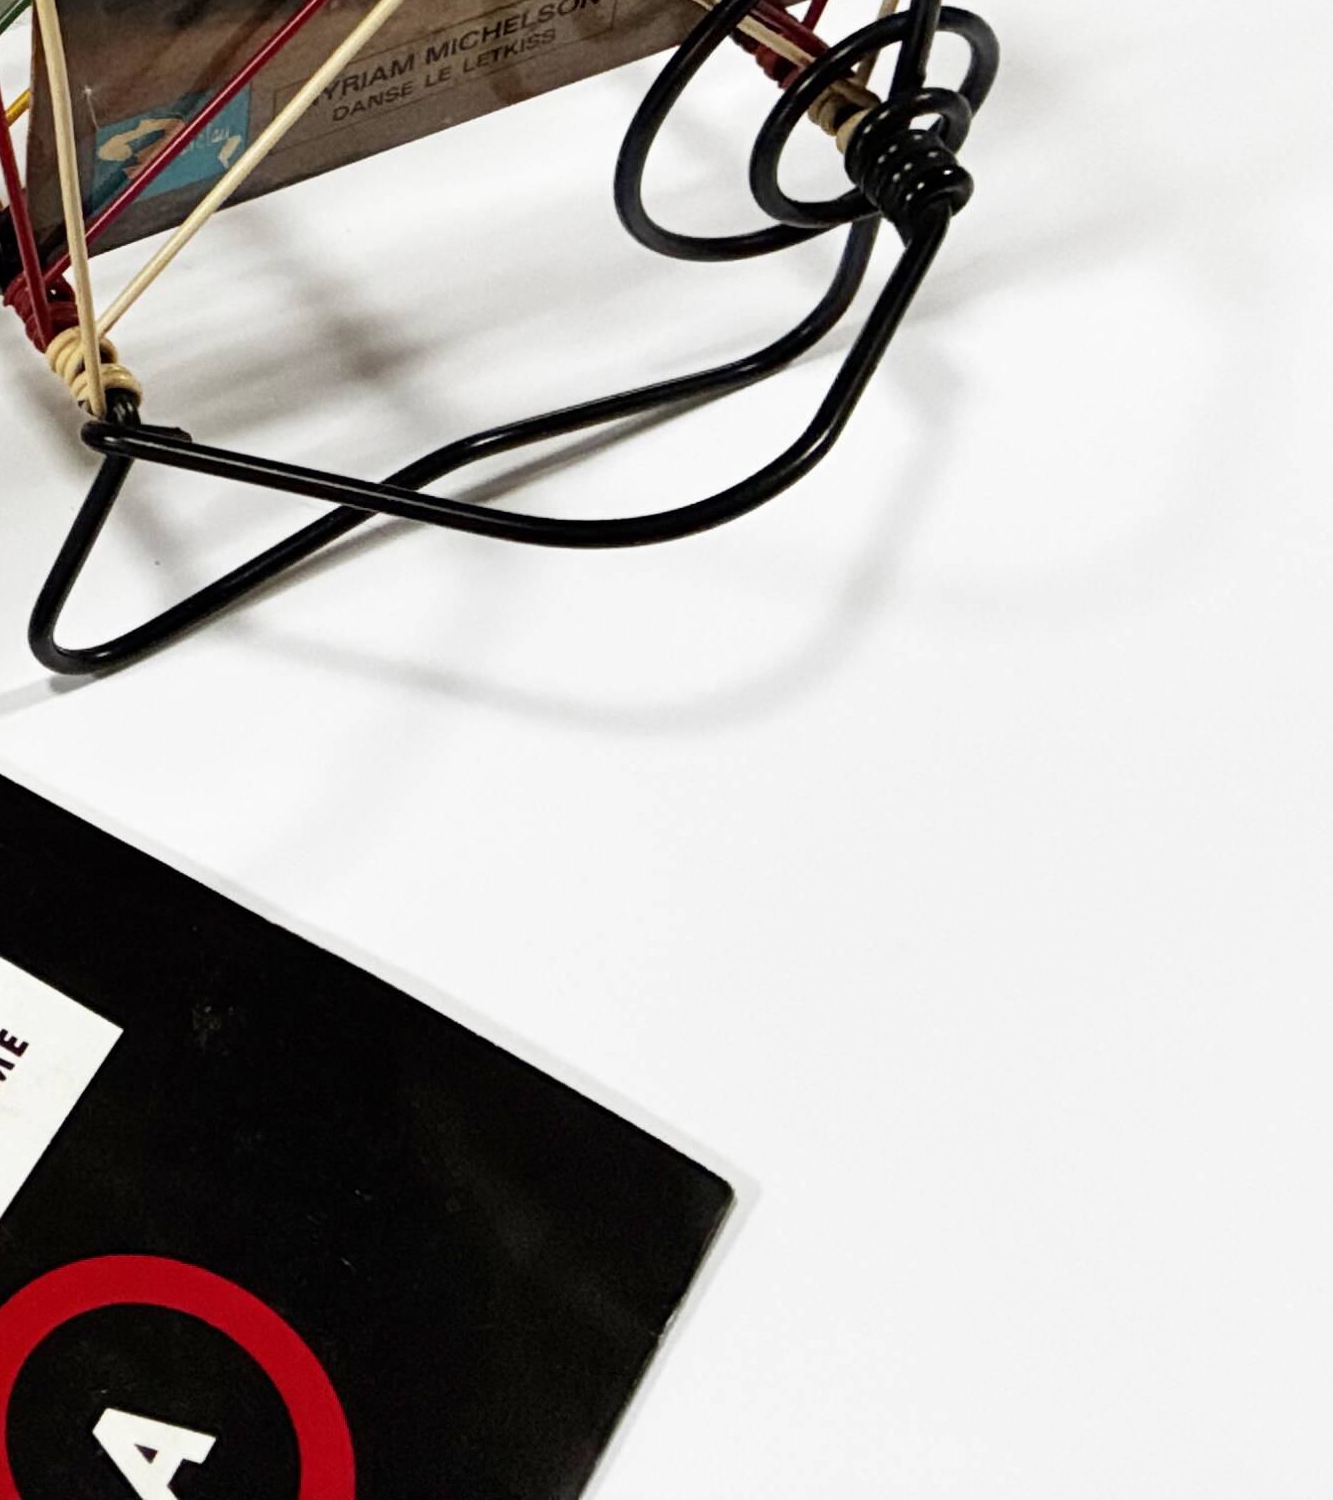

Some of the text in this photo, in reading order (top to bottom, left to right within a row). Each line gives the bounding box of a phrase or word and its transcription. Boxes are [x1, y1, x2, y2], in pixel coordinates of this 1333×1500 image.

[309, 52, 416, 108] YRIAM
[332, 26, 556, 123] DANSE LE LETKISS
[91, 1407, 217, 1500] A
